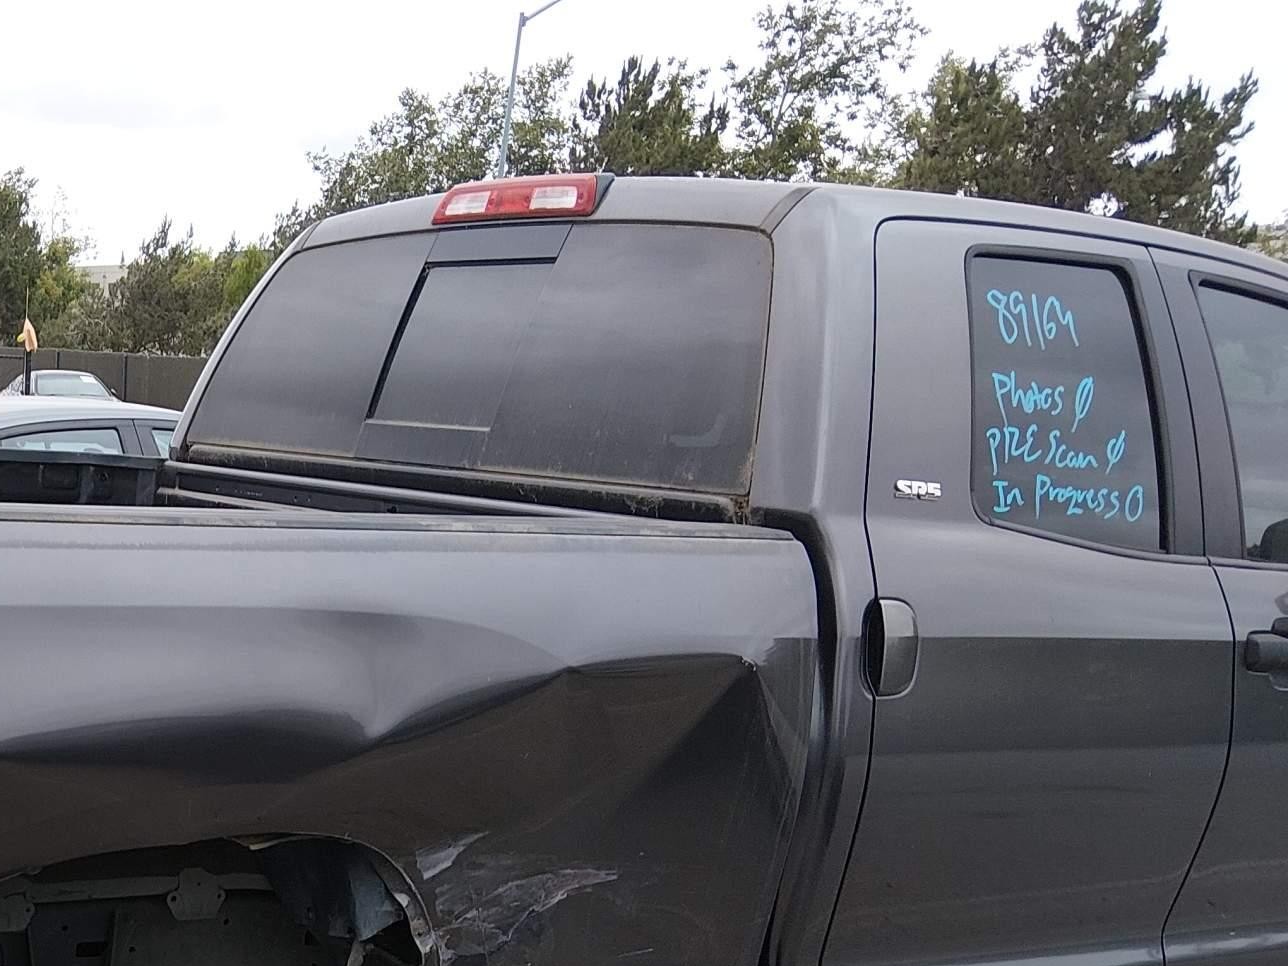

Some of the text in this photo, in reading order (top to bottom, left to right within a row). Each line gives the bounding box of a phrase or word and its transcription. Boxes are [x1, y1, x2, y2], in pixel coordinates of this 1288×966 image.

[992, 370, 1064, 425] Photos
[992, 480, 1025, 513] In
[1035, 473, 1120, 520] Progress
